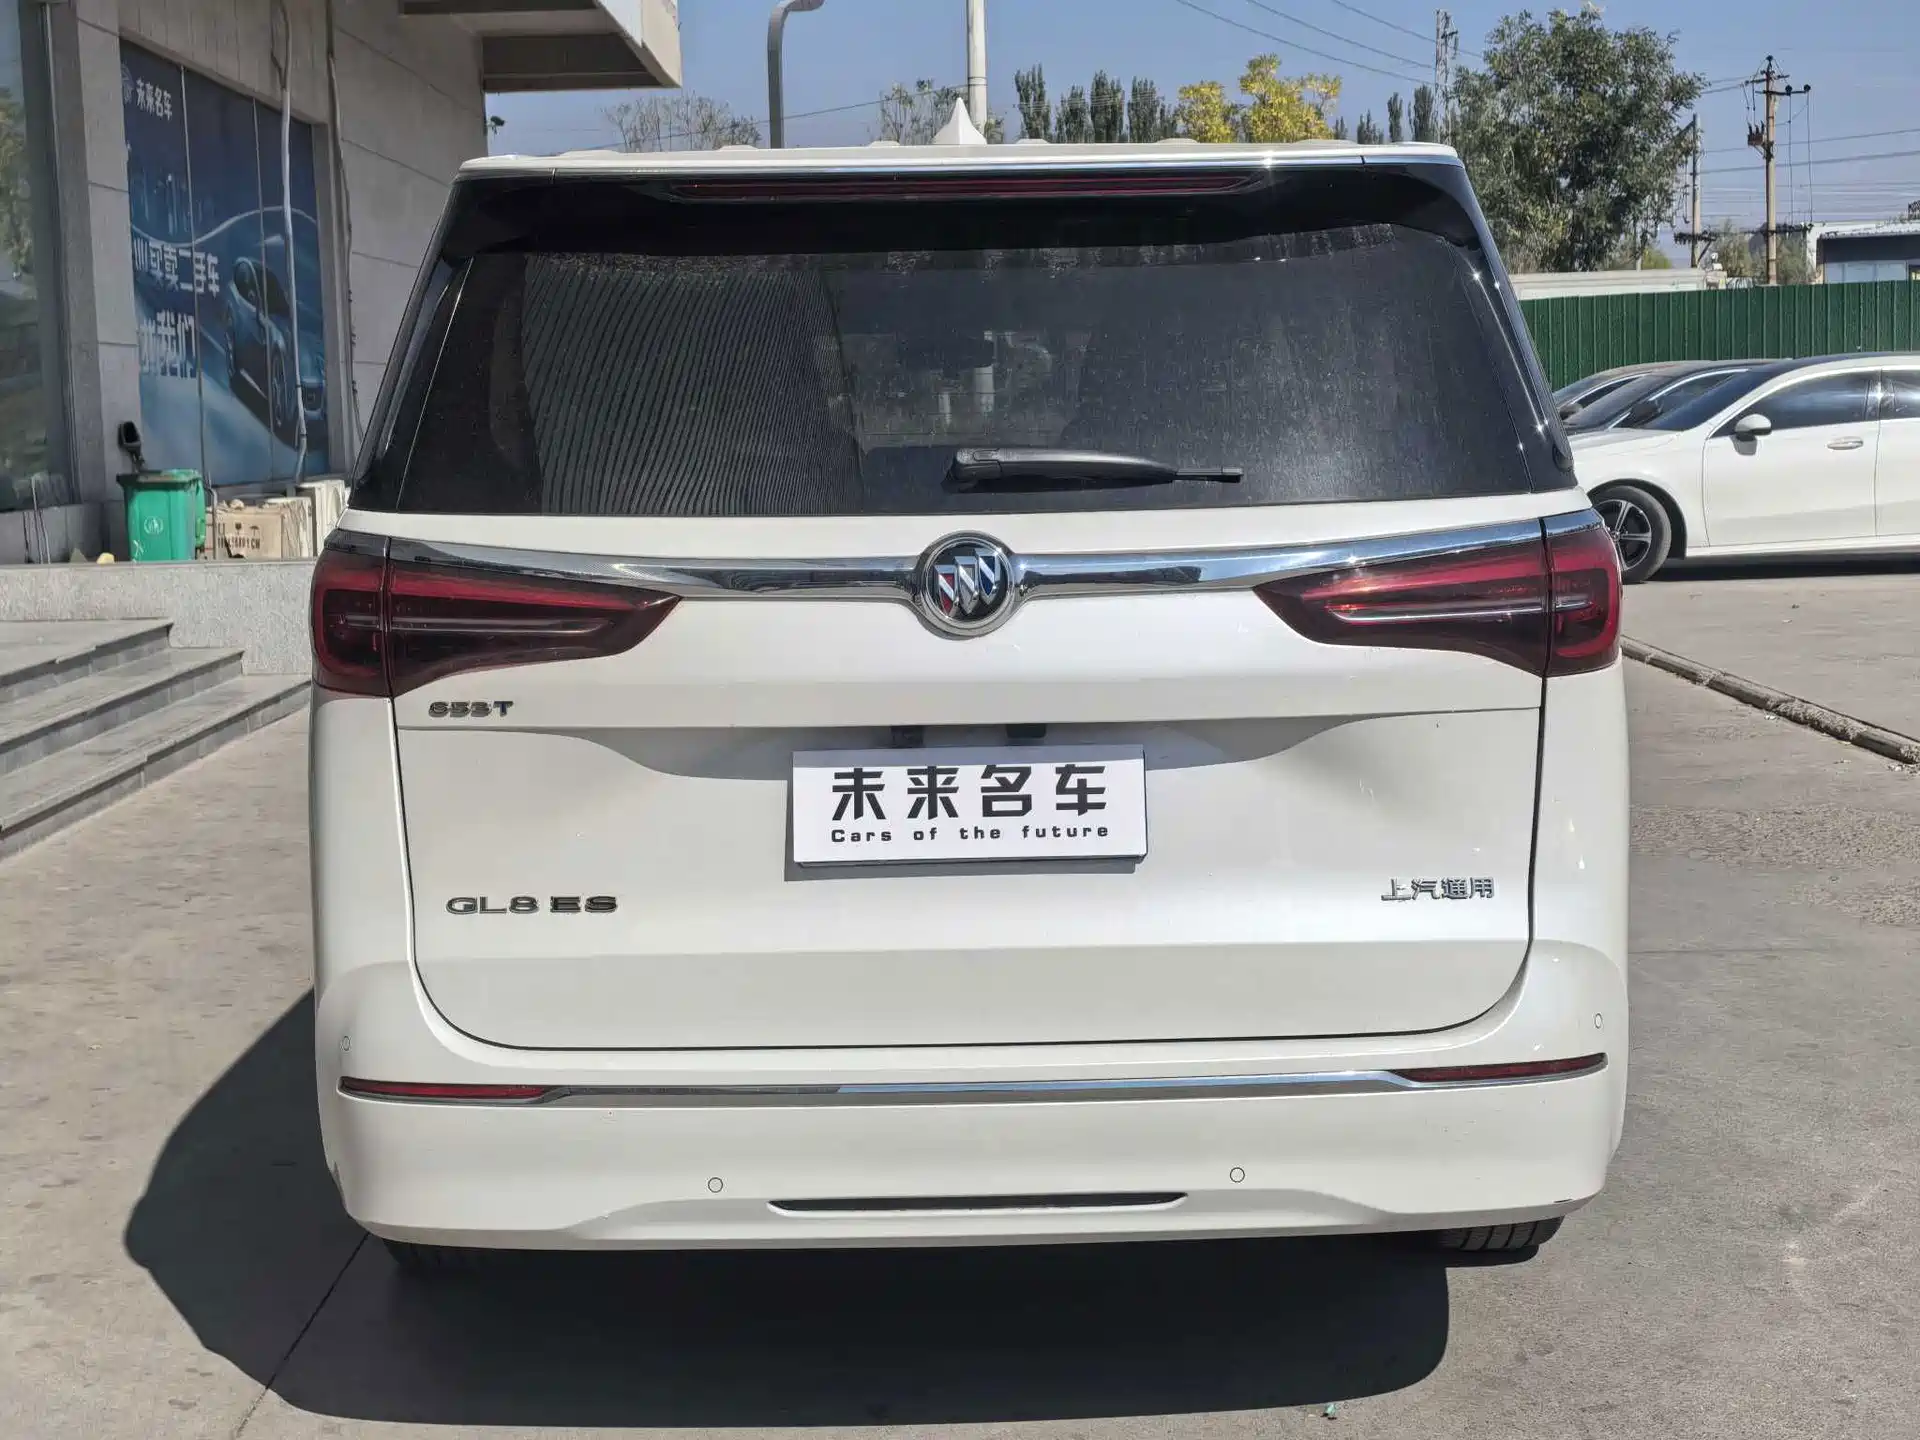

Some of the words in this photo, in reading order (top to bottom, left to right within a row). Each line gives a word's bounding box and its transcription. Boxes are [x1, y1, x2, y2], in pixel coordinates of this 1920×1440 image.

[136, 78, 172, 121] 未来名车
[428, 700, 515, 718] 653T
[831, 763, 1107, 821] 未来名车
[831, 829, 892, 843] Cars
[913, 827, 939, 841] of
[960, 826, 1001, 840] the
[1022, 824, 1109, 839] future
[1380, 877, 1495, 901] 上汽通用
[446, 896, 540, 915] GL8
[549, 895, 618, 914] ES
